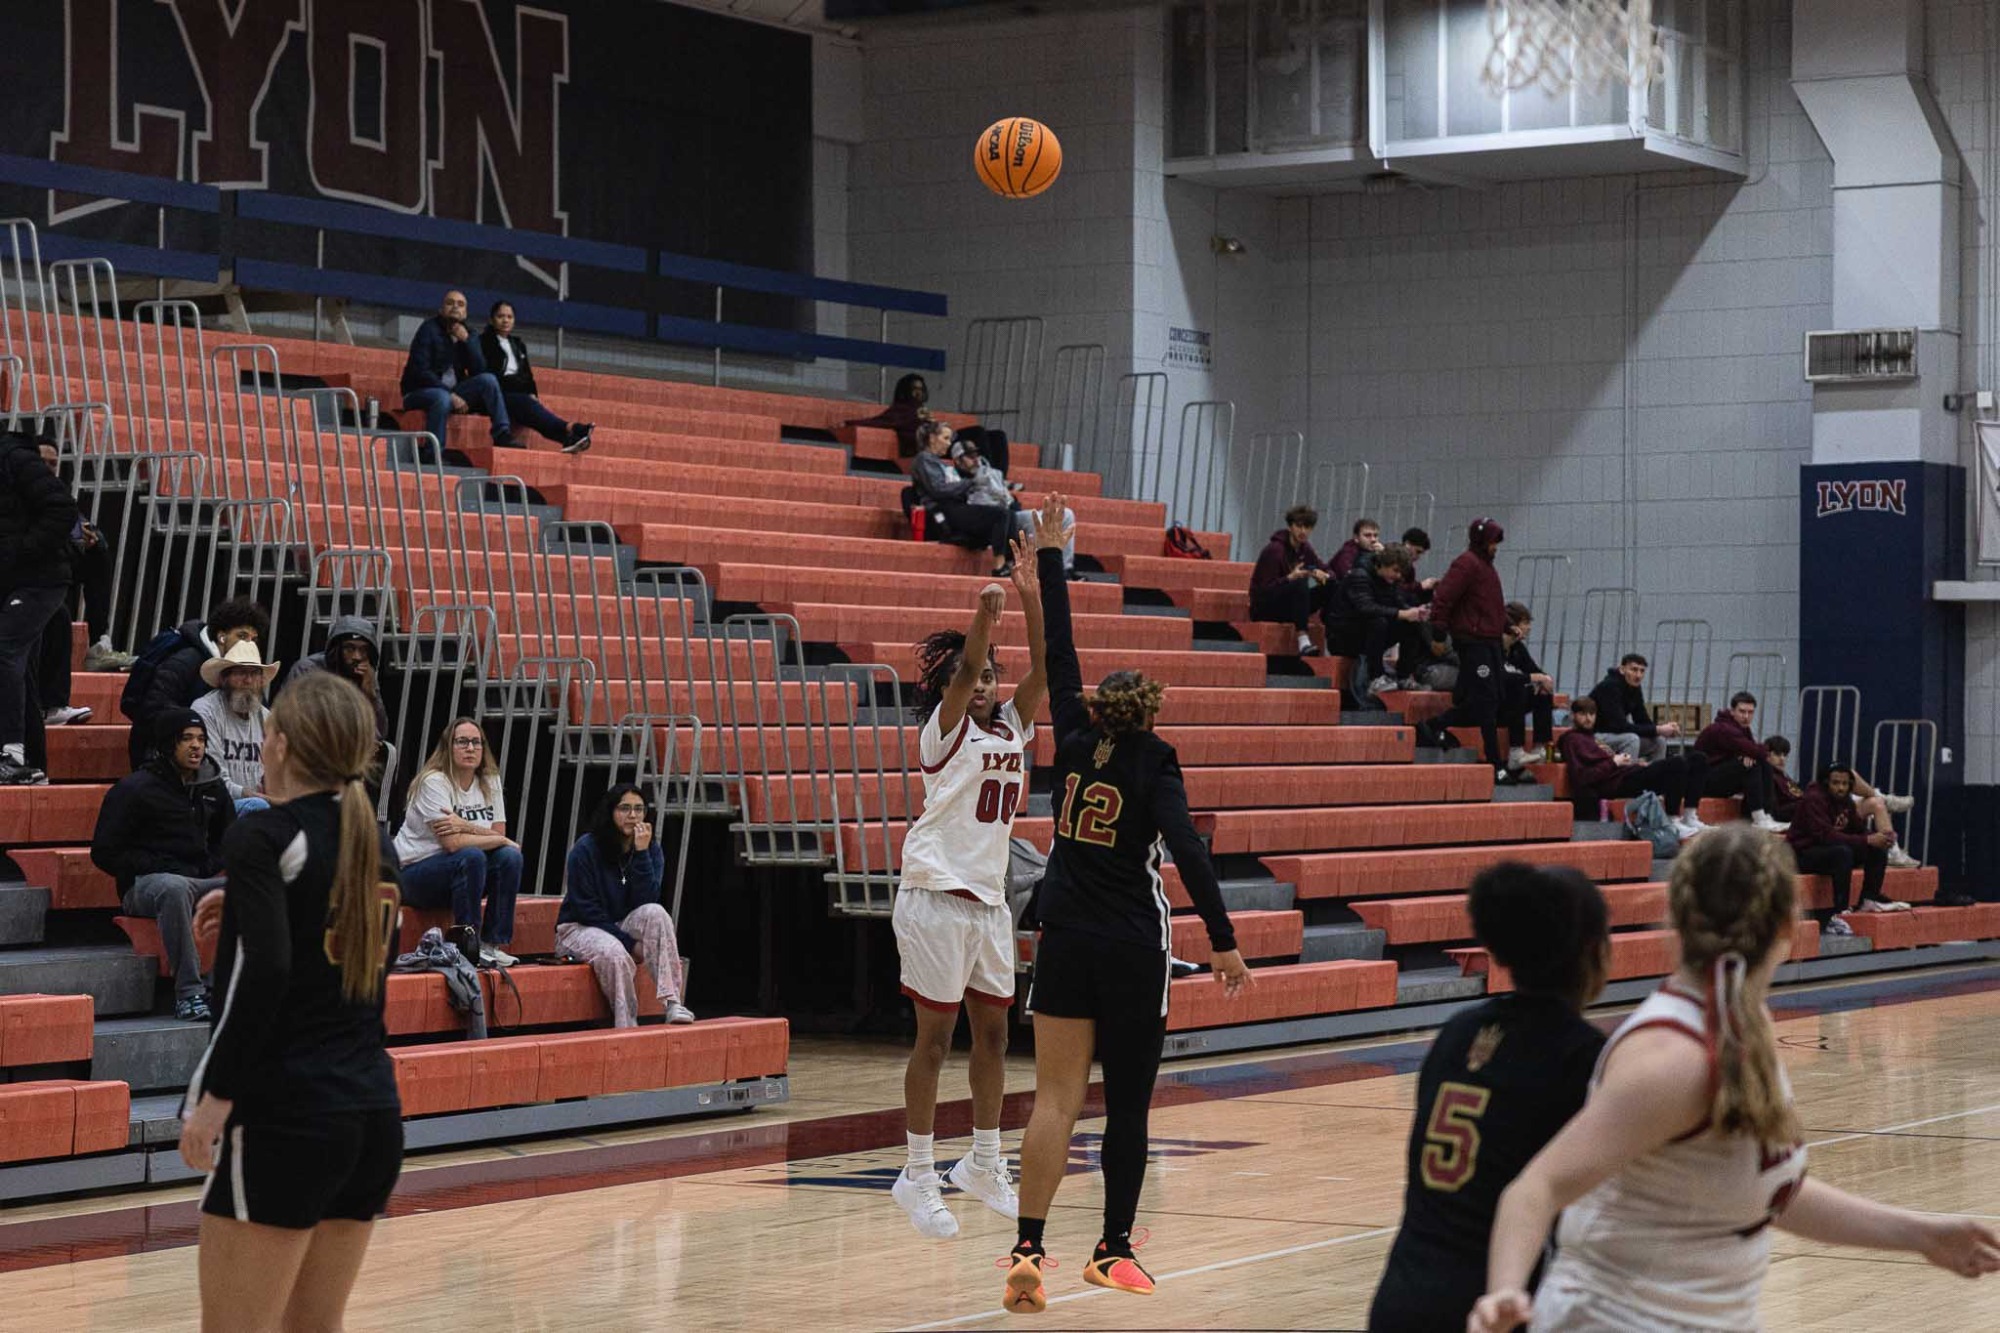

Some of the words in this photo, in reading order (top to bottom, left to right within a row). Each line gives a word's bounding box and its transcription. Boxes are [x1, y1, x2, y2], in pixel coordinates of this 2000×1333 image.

[48, 0, 570, 299] LYON
[988, 123, 1004, 161] NCAA
[1012, 121, 1033, 167] Wilson
[1817, 479, 1906, 518] LYON
[982, 752, 1023, 773] LYO
[976, 779, 1020, 825] 00
[1059, 772, 1124, 848] 12
[1421, 1081, 1491, 1192] 5
